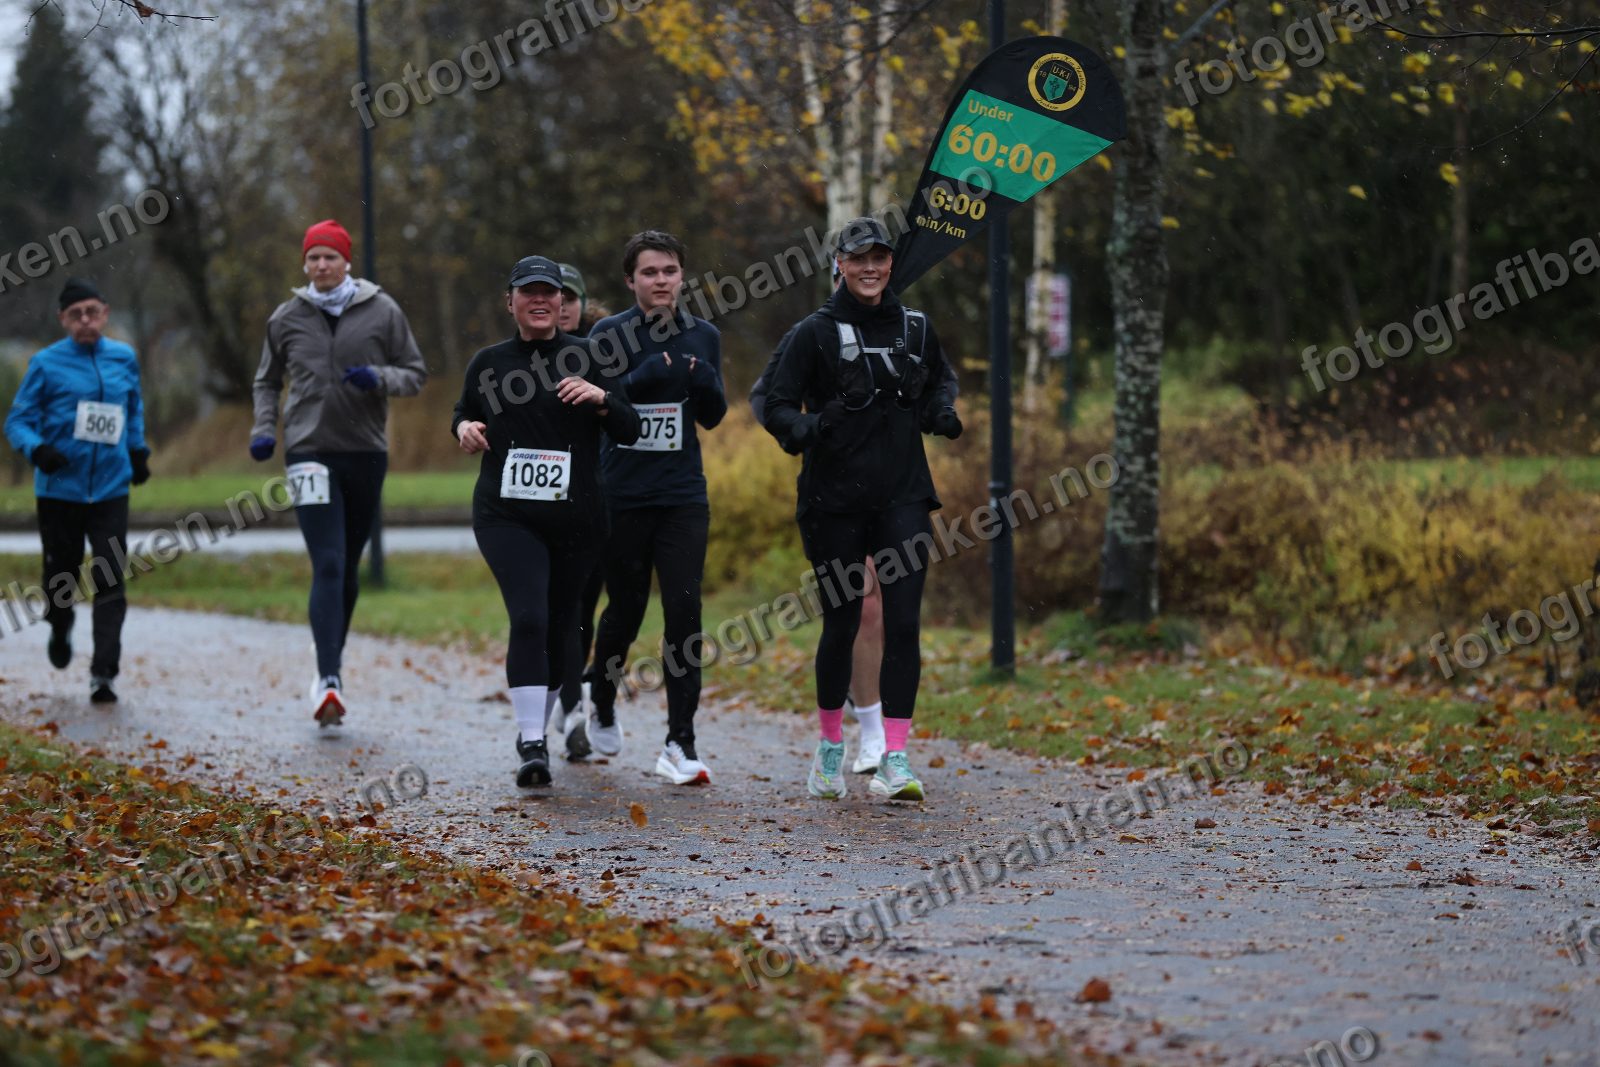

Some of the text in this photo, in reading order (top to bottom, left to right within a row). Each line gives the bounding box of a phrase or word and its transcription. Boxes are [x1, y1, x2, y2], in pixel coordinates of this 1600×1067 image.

[968, 98, 1014, 122] Under
[948, 124, 1056, 182] 60:00
[930, 186, 987, 221] 6:00
[915, 214, 967, 240] min/km
[86, 413, 117, 434] 506
[510, 462, 563, 488] 1082
